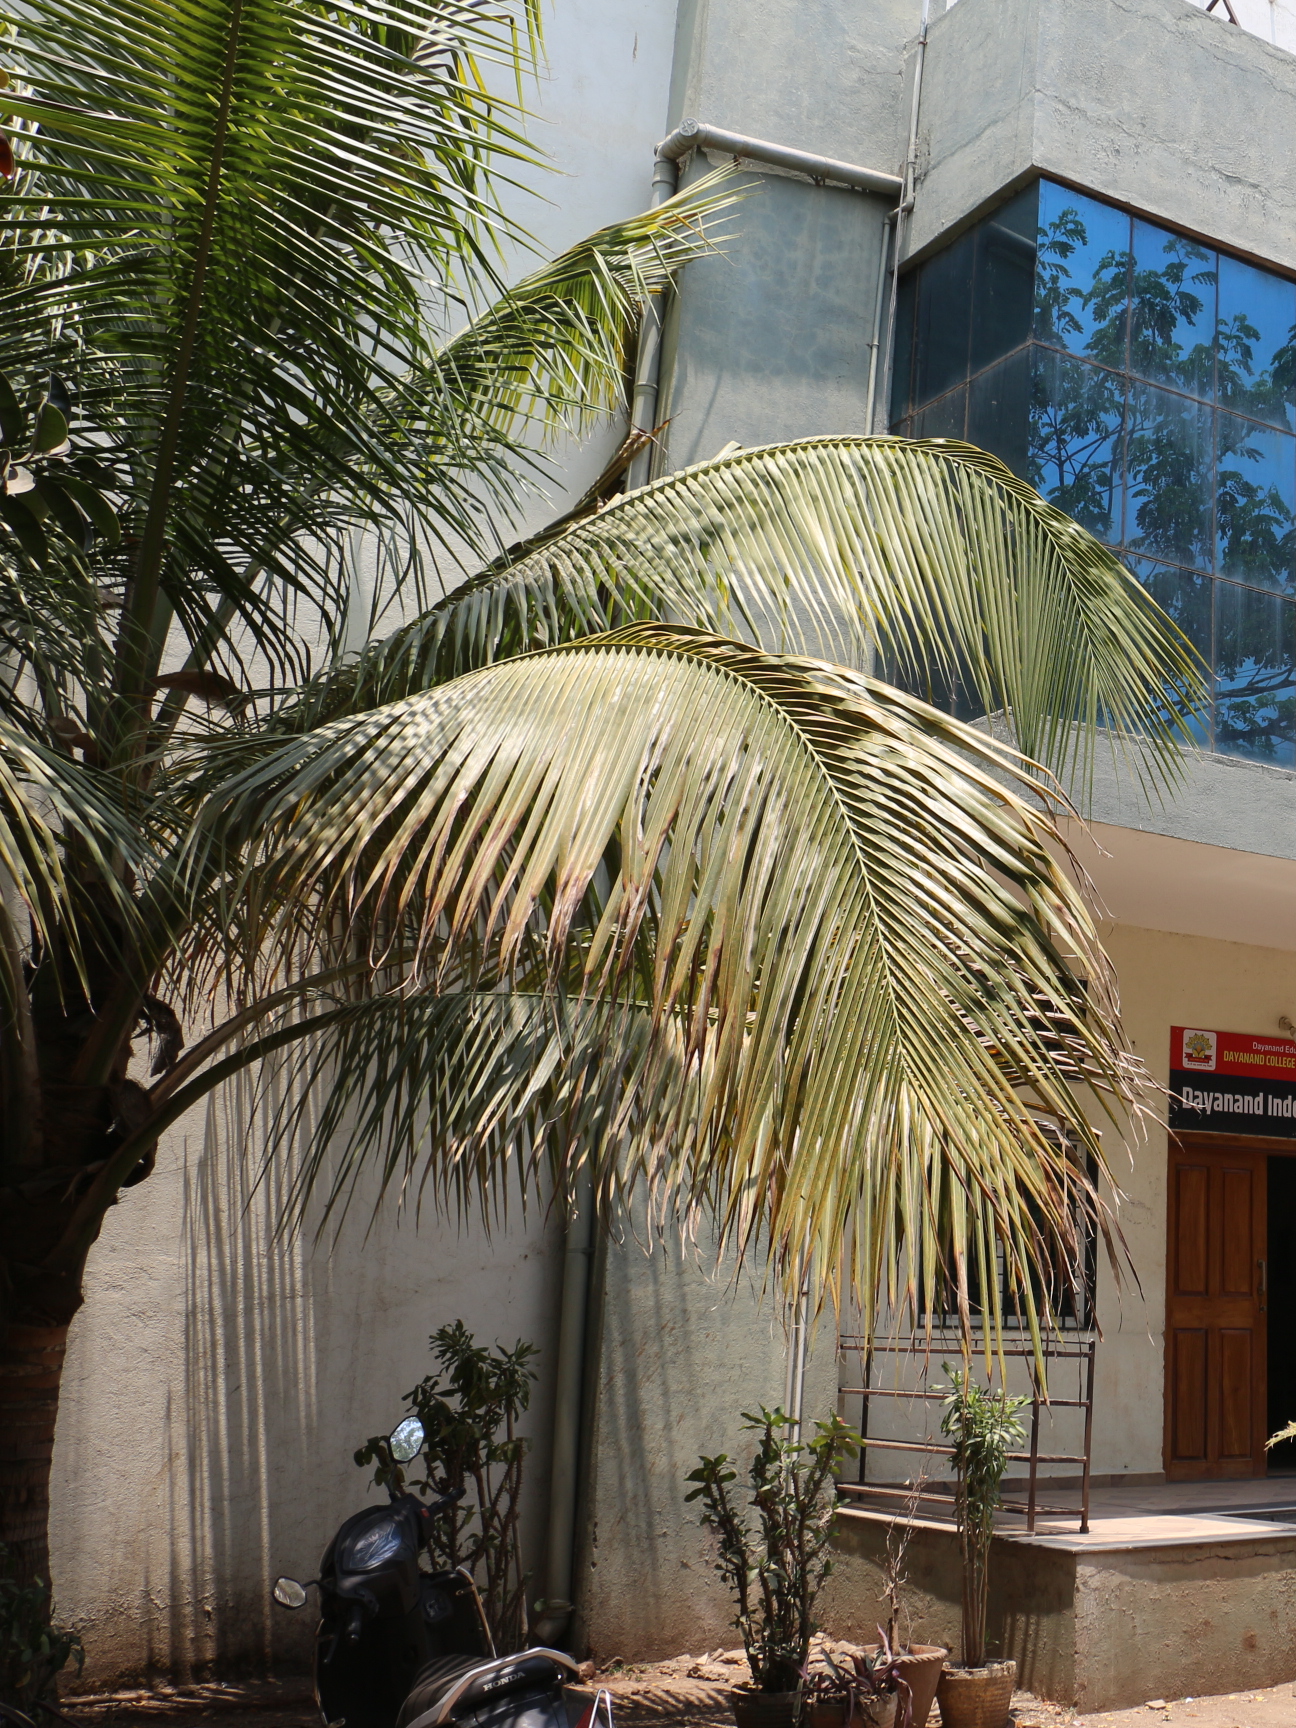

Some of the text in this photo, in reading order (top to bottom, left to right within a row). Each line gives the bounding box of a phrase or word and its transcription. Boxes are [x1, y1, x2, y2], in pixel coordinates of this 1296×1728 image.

[1253, 1041, 1284, 1052] Dayanand
[1223, 1050, 1265, 1065] DAYANAND
[1266, 1055, 1296, 1069] COLLEGE
[1182, 1086, 1264, 1114] Dayanand
[483, 1672, 526, 1692] HONDA
